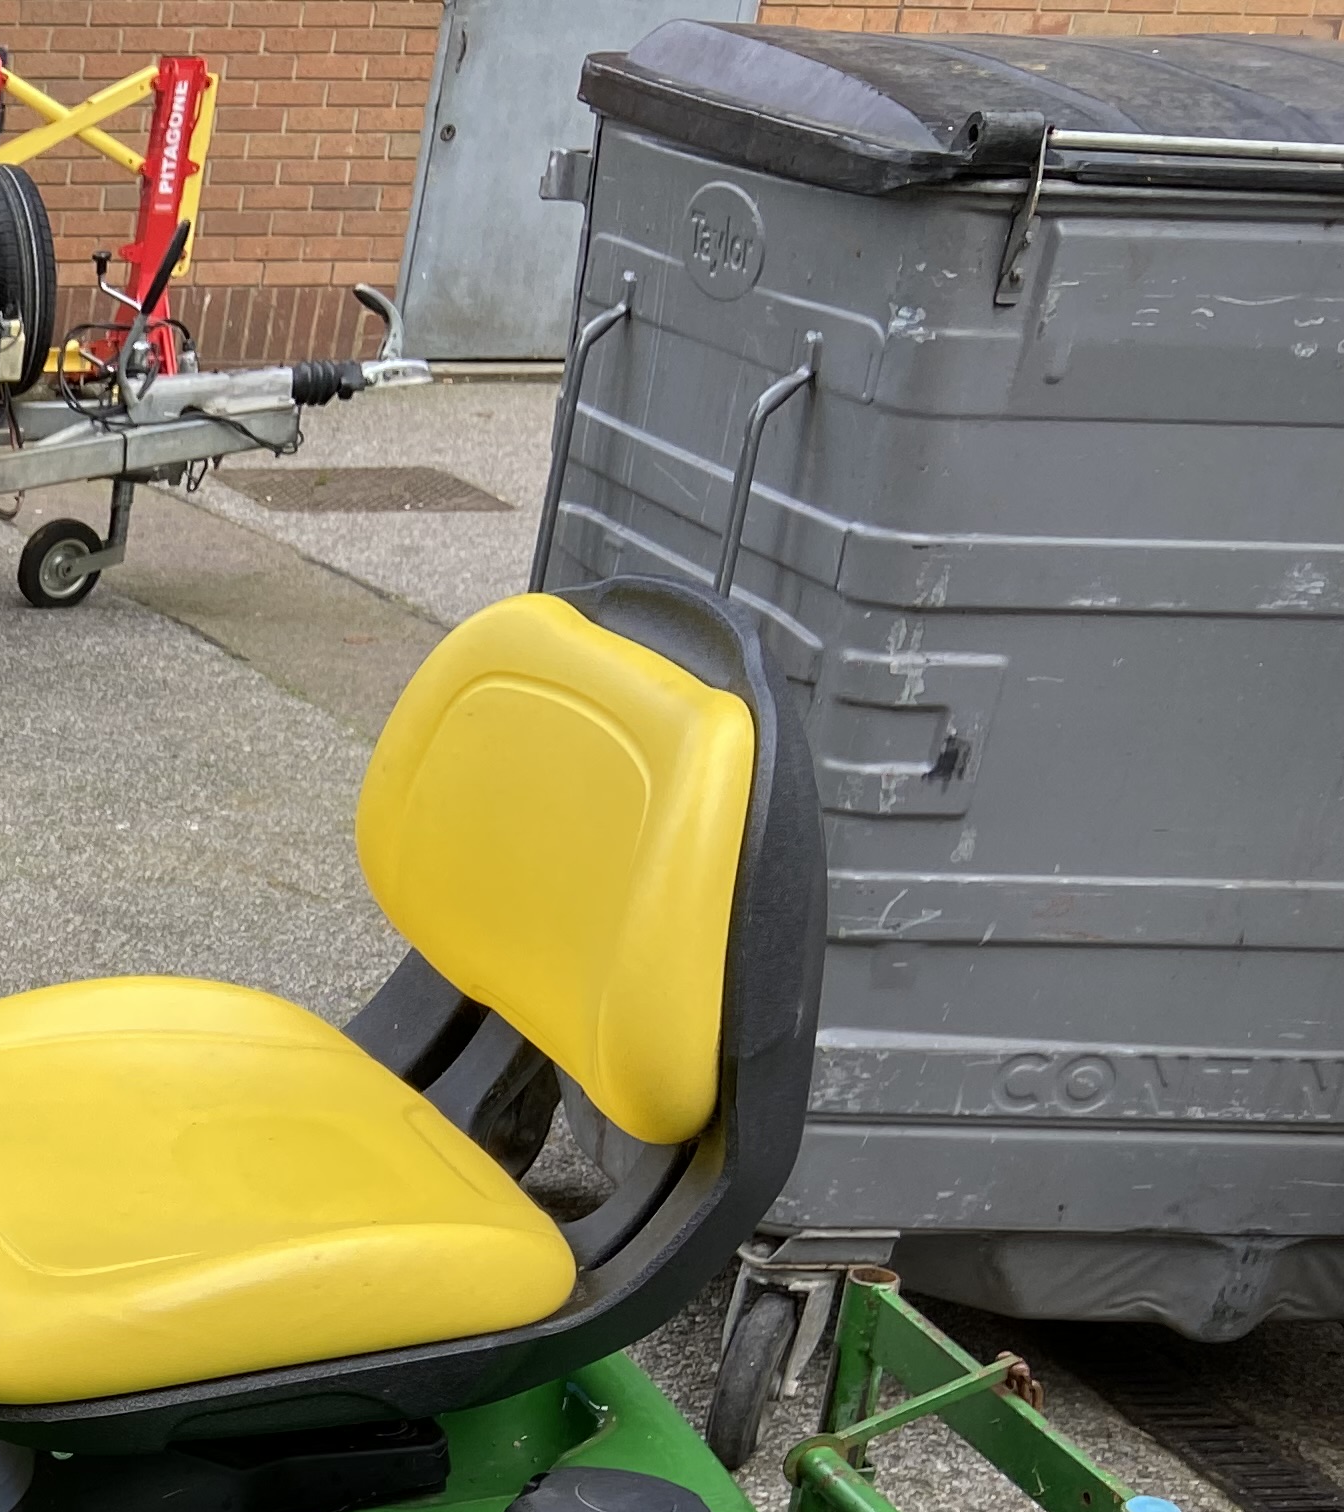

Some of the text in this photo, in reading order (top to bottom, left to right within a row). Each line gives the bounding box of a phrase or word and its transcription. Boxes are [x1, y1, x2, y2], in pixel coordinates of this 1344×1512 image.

[158, 80, 189, 195] PITAGONE
[691, 209, 754, 278] Taylor
[992, 1052, 1344, 1119] CONTIN
